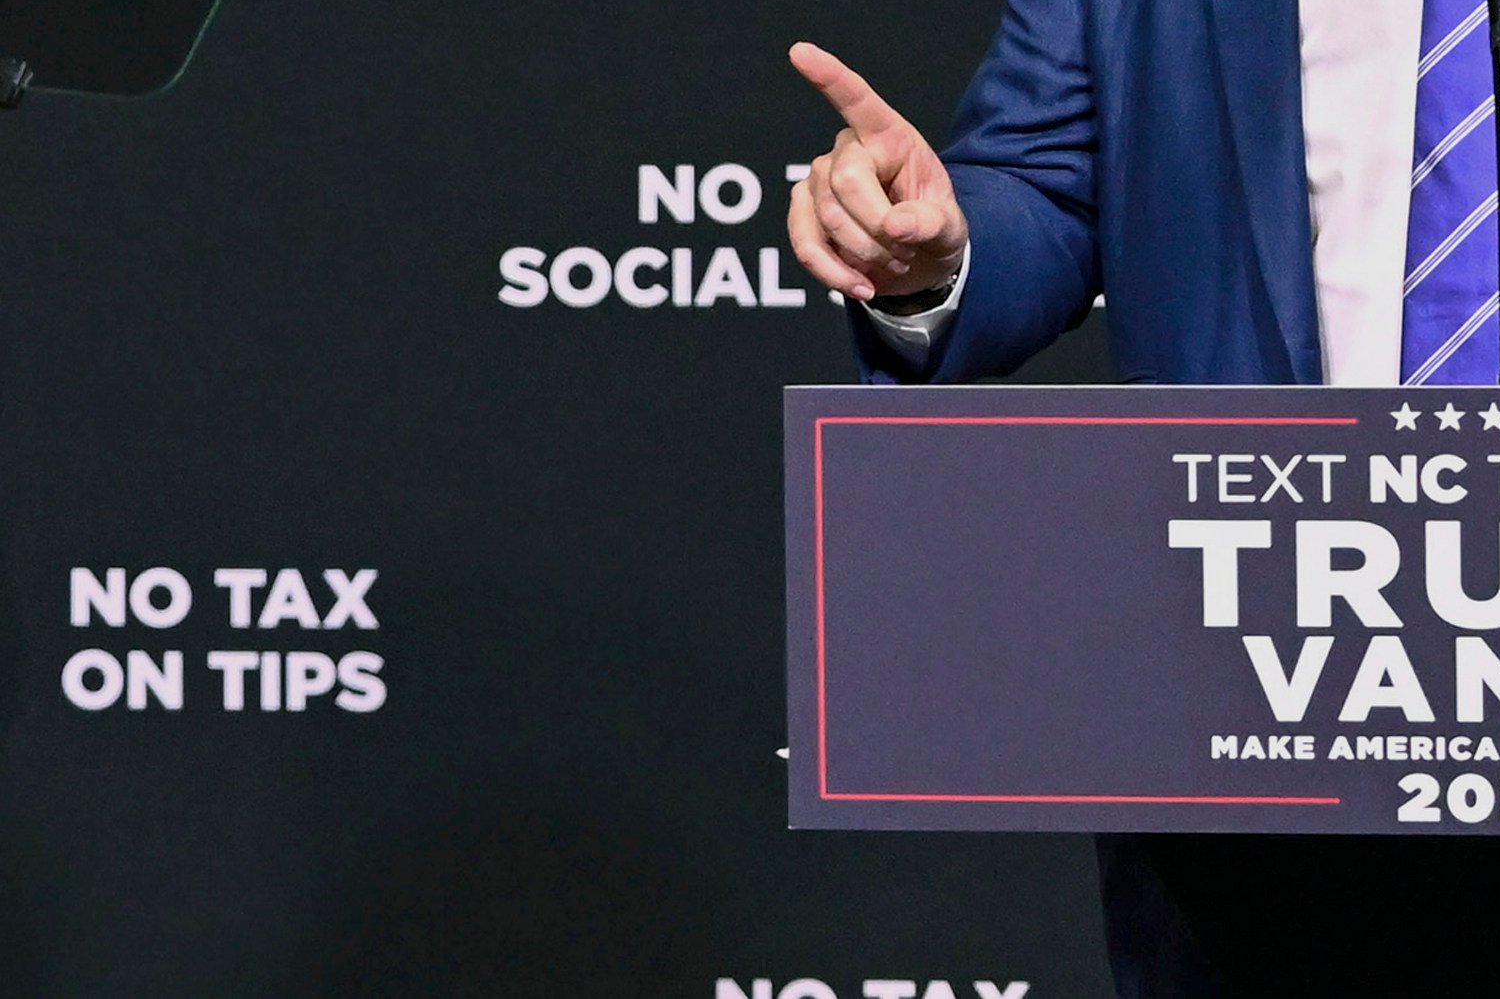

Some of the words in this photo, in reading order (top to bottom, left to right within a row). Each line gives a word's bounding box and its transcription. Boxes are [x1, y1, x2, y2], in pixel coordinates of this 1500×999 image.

[638, 163, 763, 225] NO
[497, 247, 806, 308] SOCIAL
[1171, 453, 1347, 504] TEXT
[1369, 453, 1469, 505] NC
[70, 566, 193, 629] NO
[213, 568, 379, 630] TAX
[61, 648, 184, 711] ON
[207, 650, 387, 713] TIPS
[1210, 734, 1316, 761] MAKE
[1327, 735, 1500, 762] AMERICA
